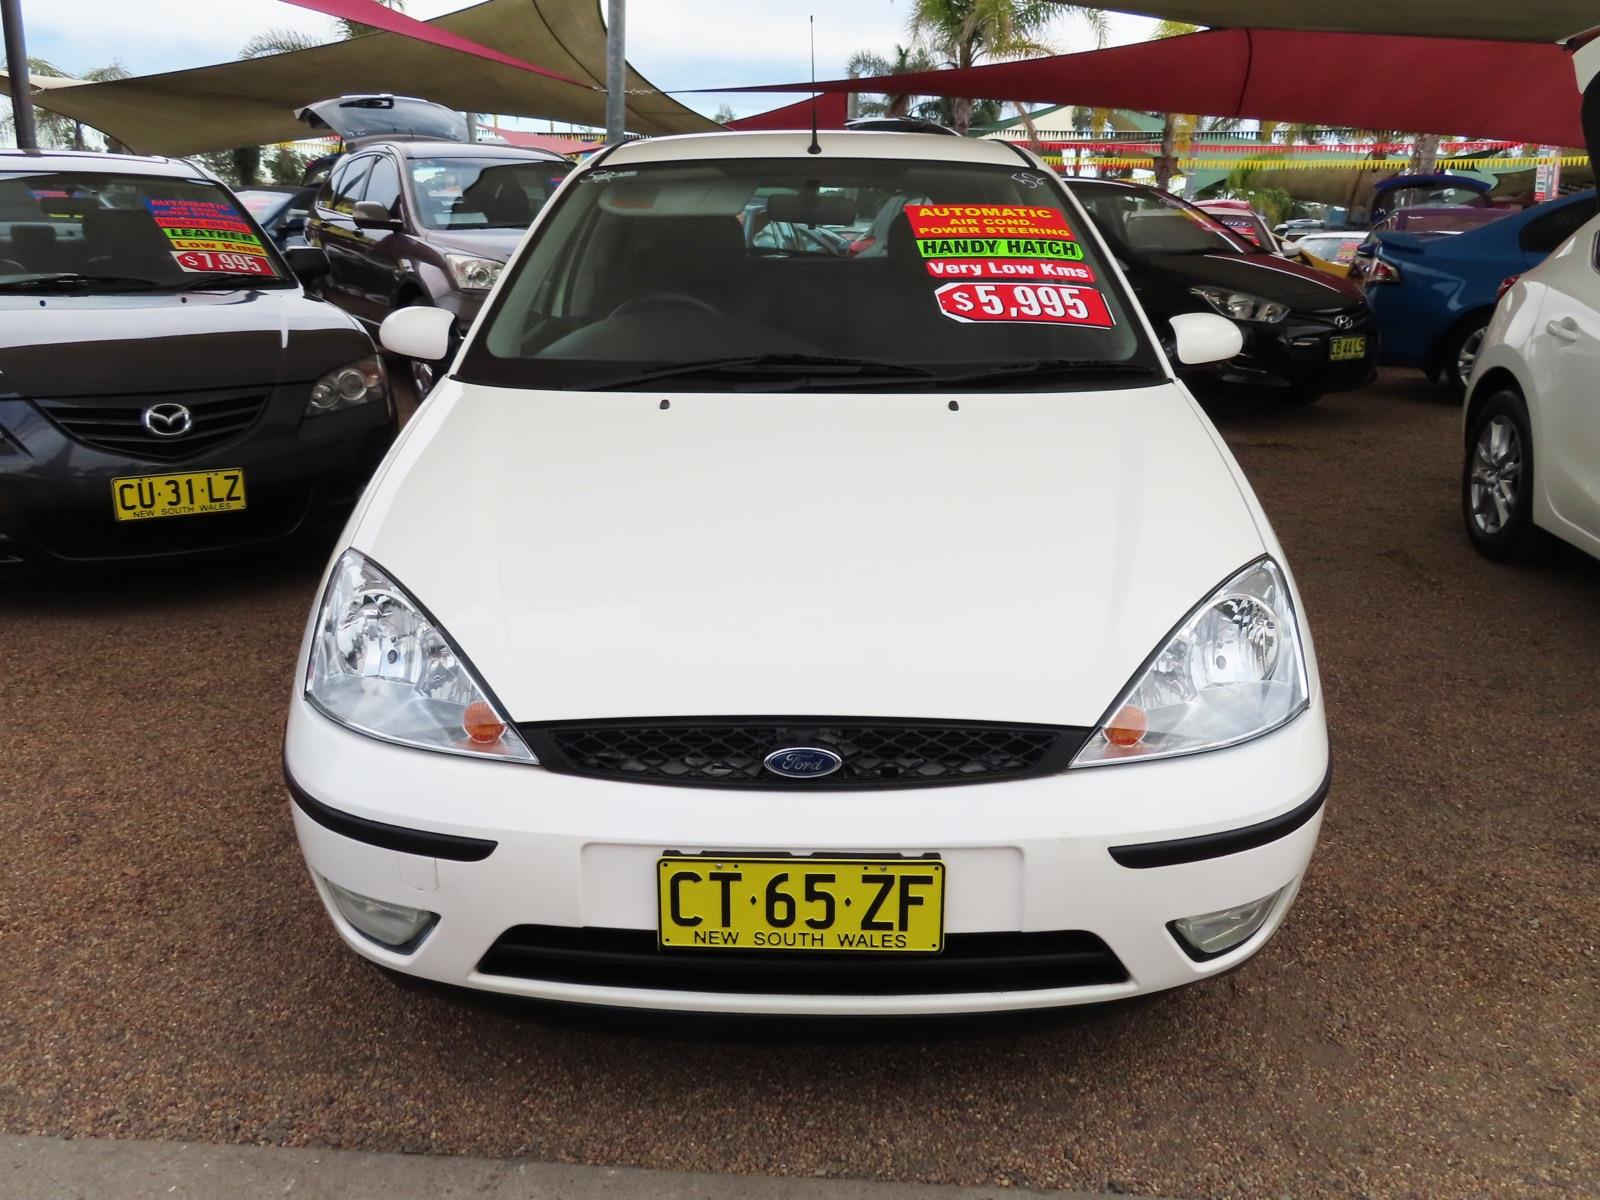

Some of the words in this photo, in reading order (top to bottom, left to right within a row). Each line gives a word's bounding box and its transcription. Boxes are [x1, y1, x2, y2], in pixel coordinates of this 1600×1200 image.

[919, 207, 1053, 219] AUTOMATIC
[949, 218, 978, 226] AIR
[983, 218, 1036, 227] COND.
[170, 228, 255, 241] LEATHER
[919, 227, 981, 235] POWER
[985, 227, 1070, 237] STEERING
[175, 241, 215, 249] Low
[222, 242, 262, 254] Kms
[922, 240, 999, 255] HANDY
[1007, 240, 1077, 256] HATCH
[928, 261, 982, 276] Very
[986, 262, 1034, 275] Low
[1040, 263, 1089, 278] Kms
[951, 285, 1089, 319] $5,995
[133, 510, 155, 518] NEW
[161, 506, 195, 515] SOUTH
[200, 503, 231, 511] WALES
[782, 753, 824, 770] Ford
[694, 931, 739, 945] NEW
[754, 932, 824, 947] SOUTH
[838, 933, 907, 948] WALES
